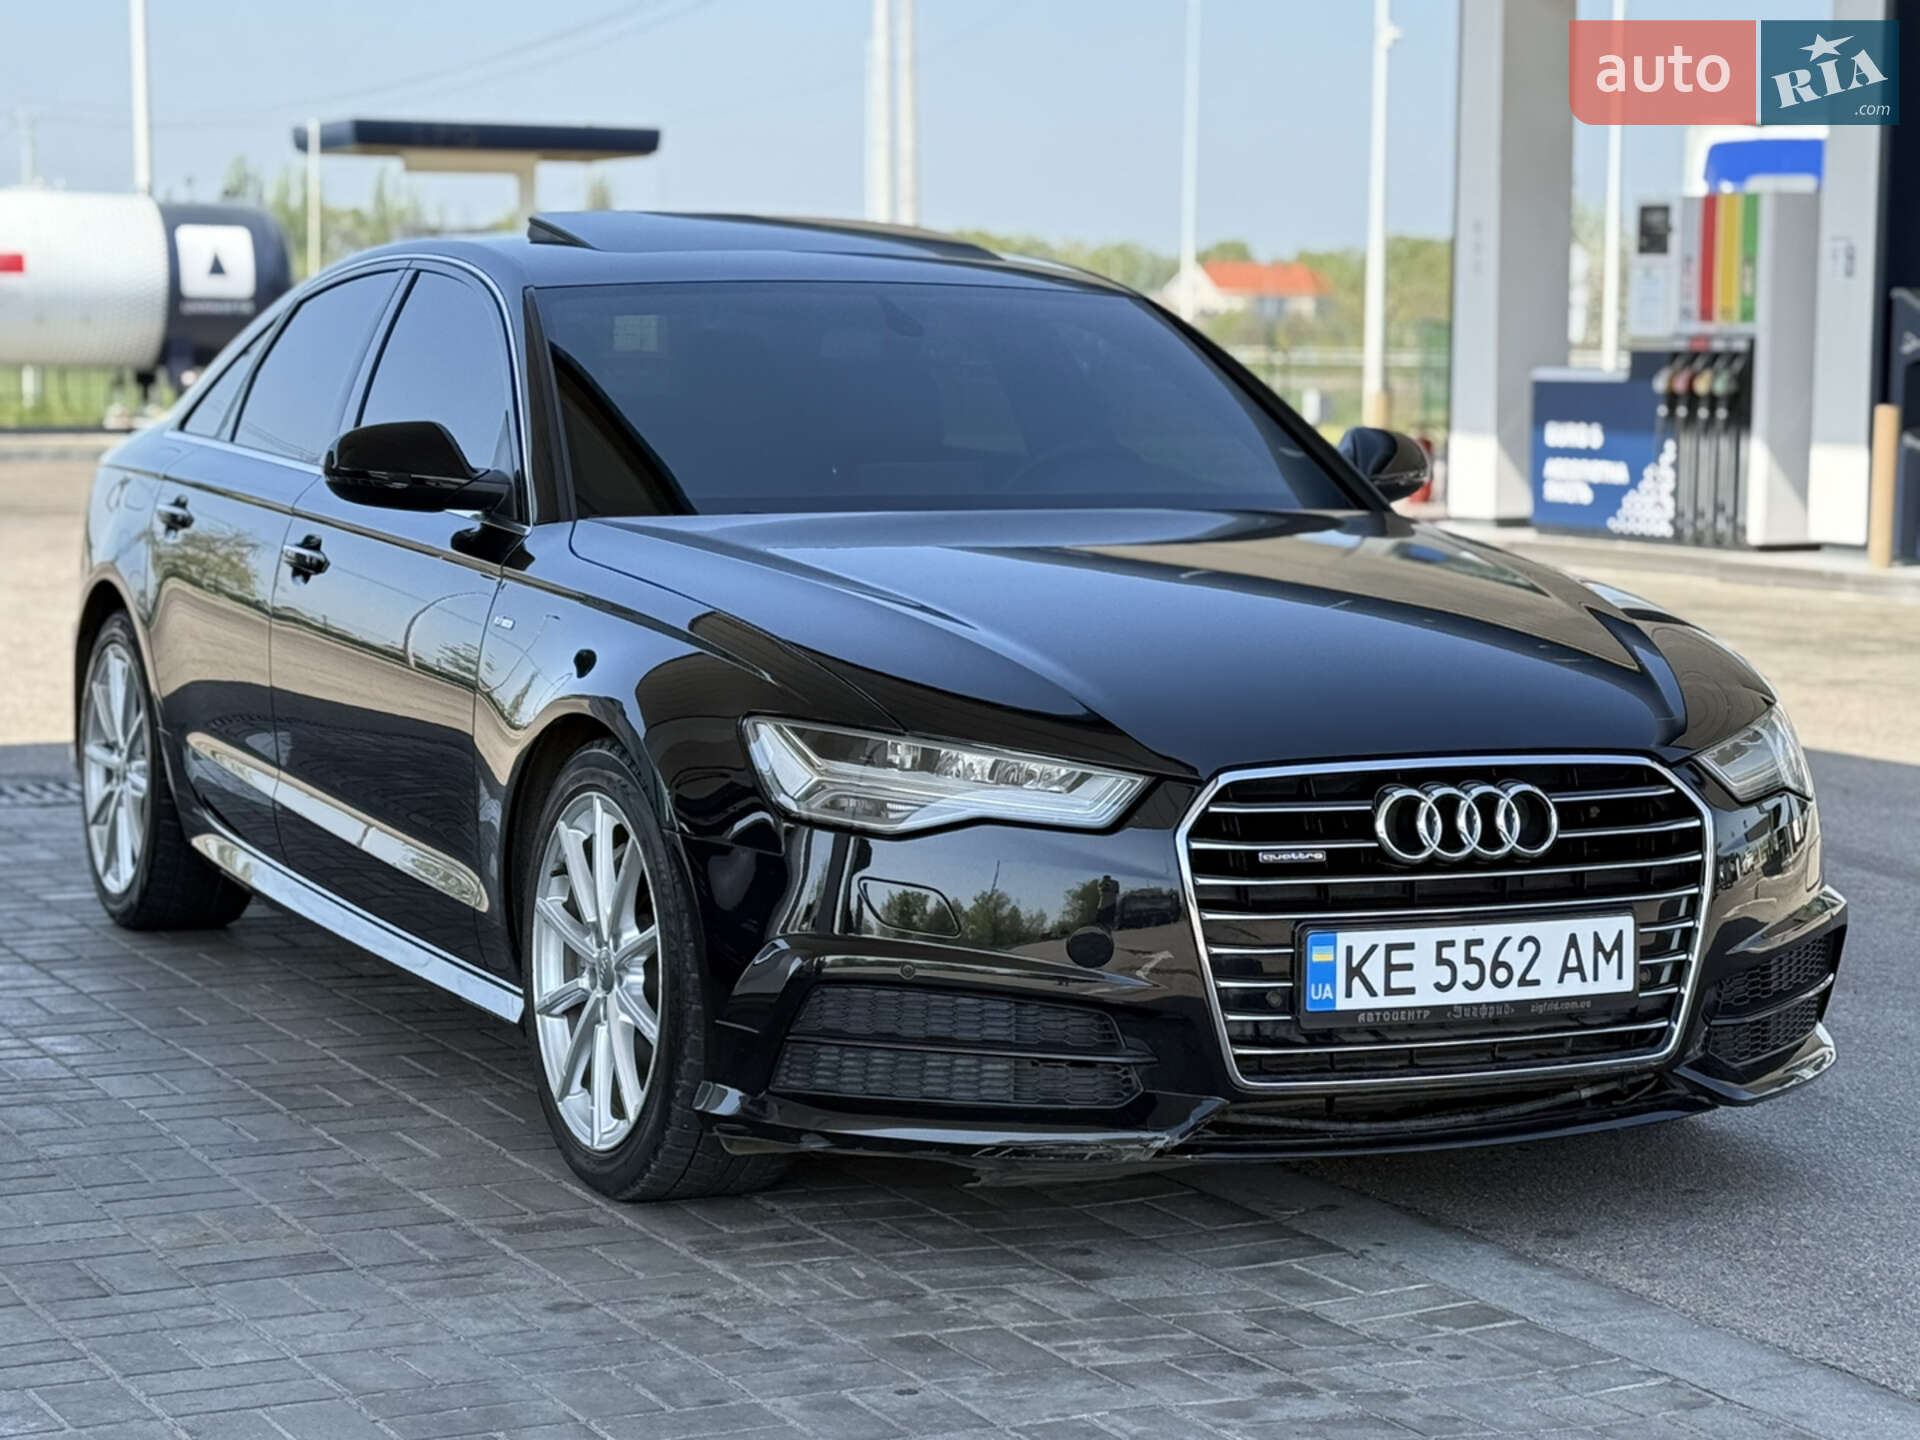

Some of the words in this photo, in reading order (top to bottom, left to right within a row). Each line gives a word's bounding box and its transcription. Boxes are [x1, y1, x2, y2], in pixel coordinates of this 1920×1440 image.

[1262, 851, 1324, 863] quattro
[1344, 941, 1417, 999] KE
[1432, 935, 1542, 993] 5562
[1556, 929, 1624, 985] AM
[1310, 983, 1334, 1001] UA
[1357, 1009, 1432, 1023] АВТОЦЕНТР
